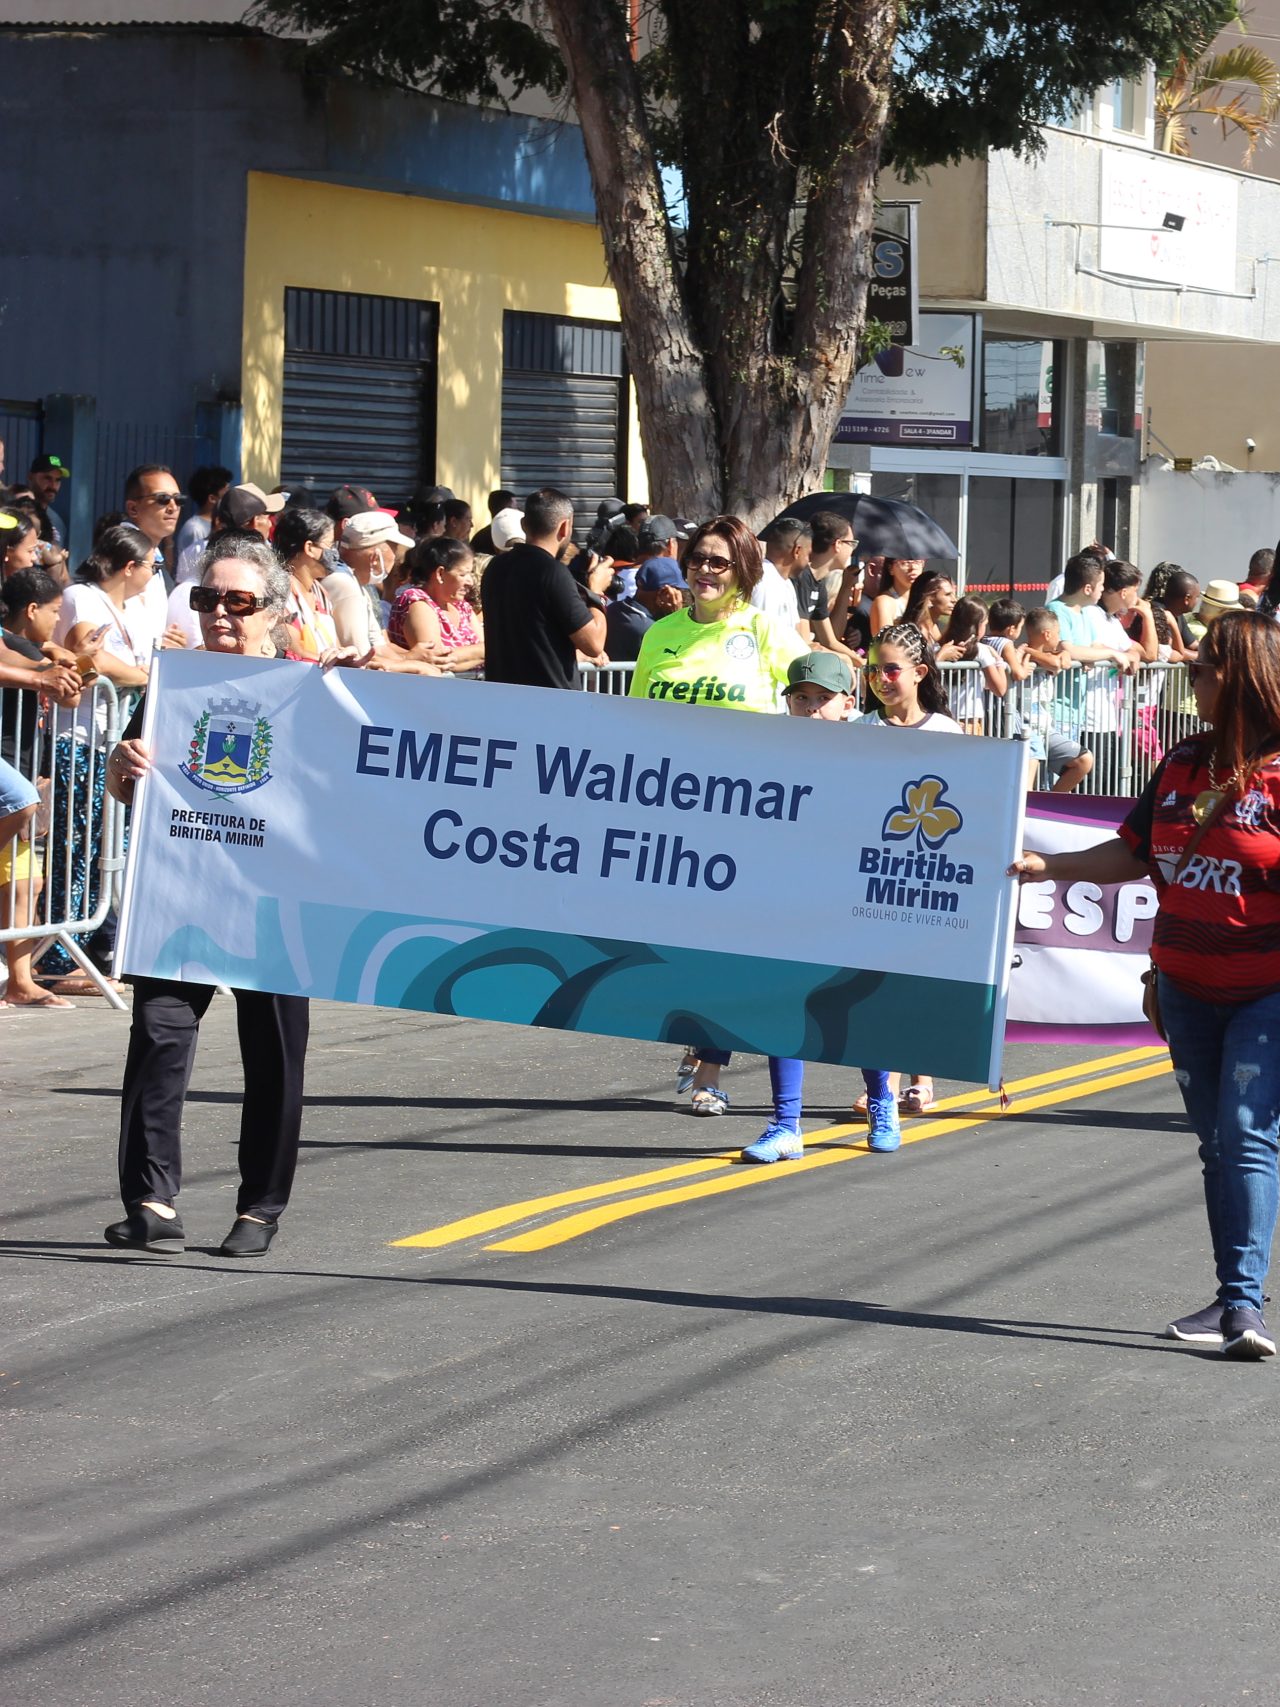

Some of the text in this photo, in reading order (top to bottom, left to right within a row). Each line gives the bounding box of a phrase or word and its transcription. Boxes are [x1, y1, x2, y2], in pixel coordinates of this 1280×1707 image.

[870, 283, 907, 300] Peças
[648, 676, 747, 705] crefisa
[355, 724, 814, 822] EMEF Waldemar
[171, 809, 266, 832] PREFEITURA DE
[169, 824, 265, 848] BIRITIBA MIRIM
[423, 808, 737, 892] Costa Filho
[858, 846, 974, 885] Biritiba
[865, 876, 959, 913] Mirim
[851, 906, 969, 930] ORGULHO DE VIVER AQUI
